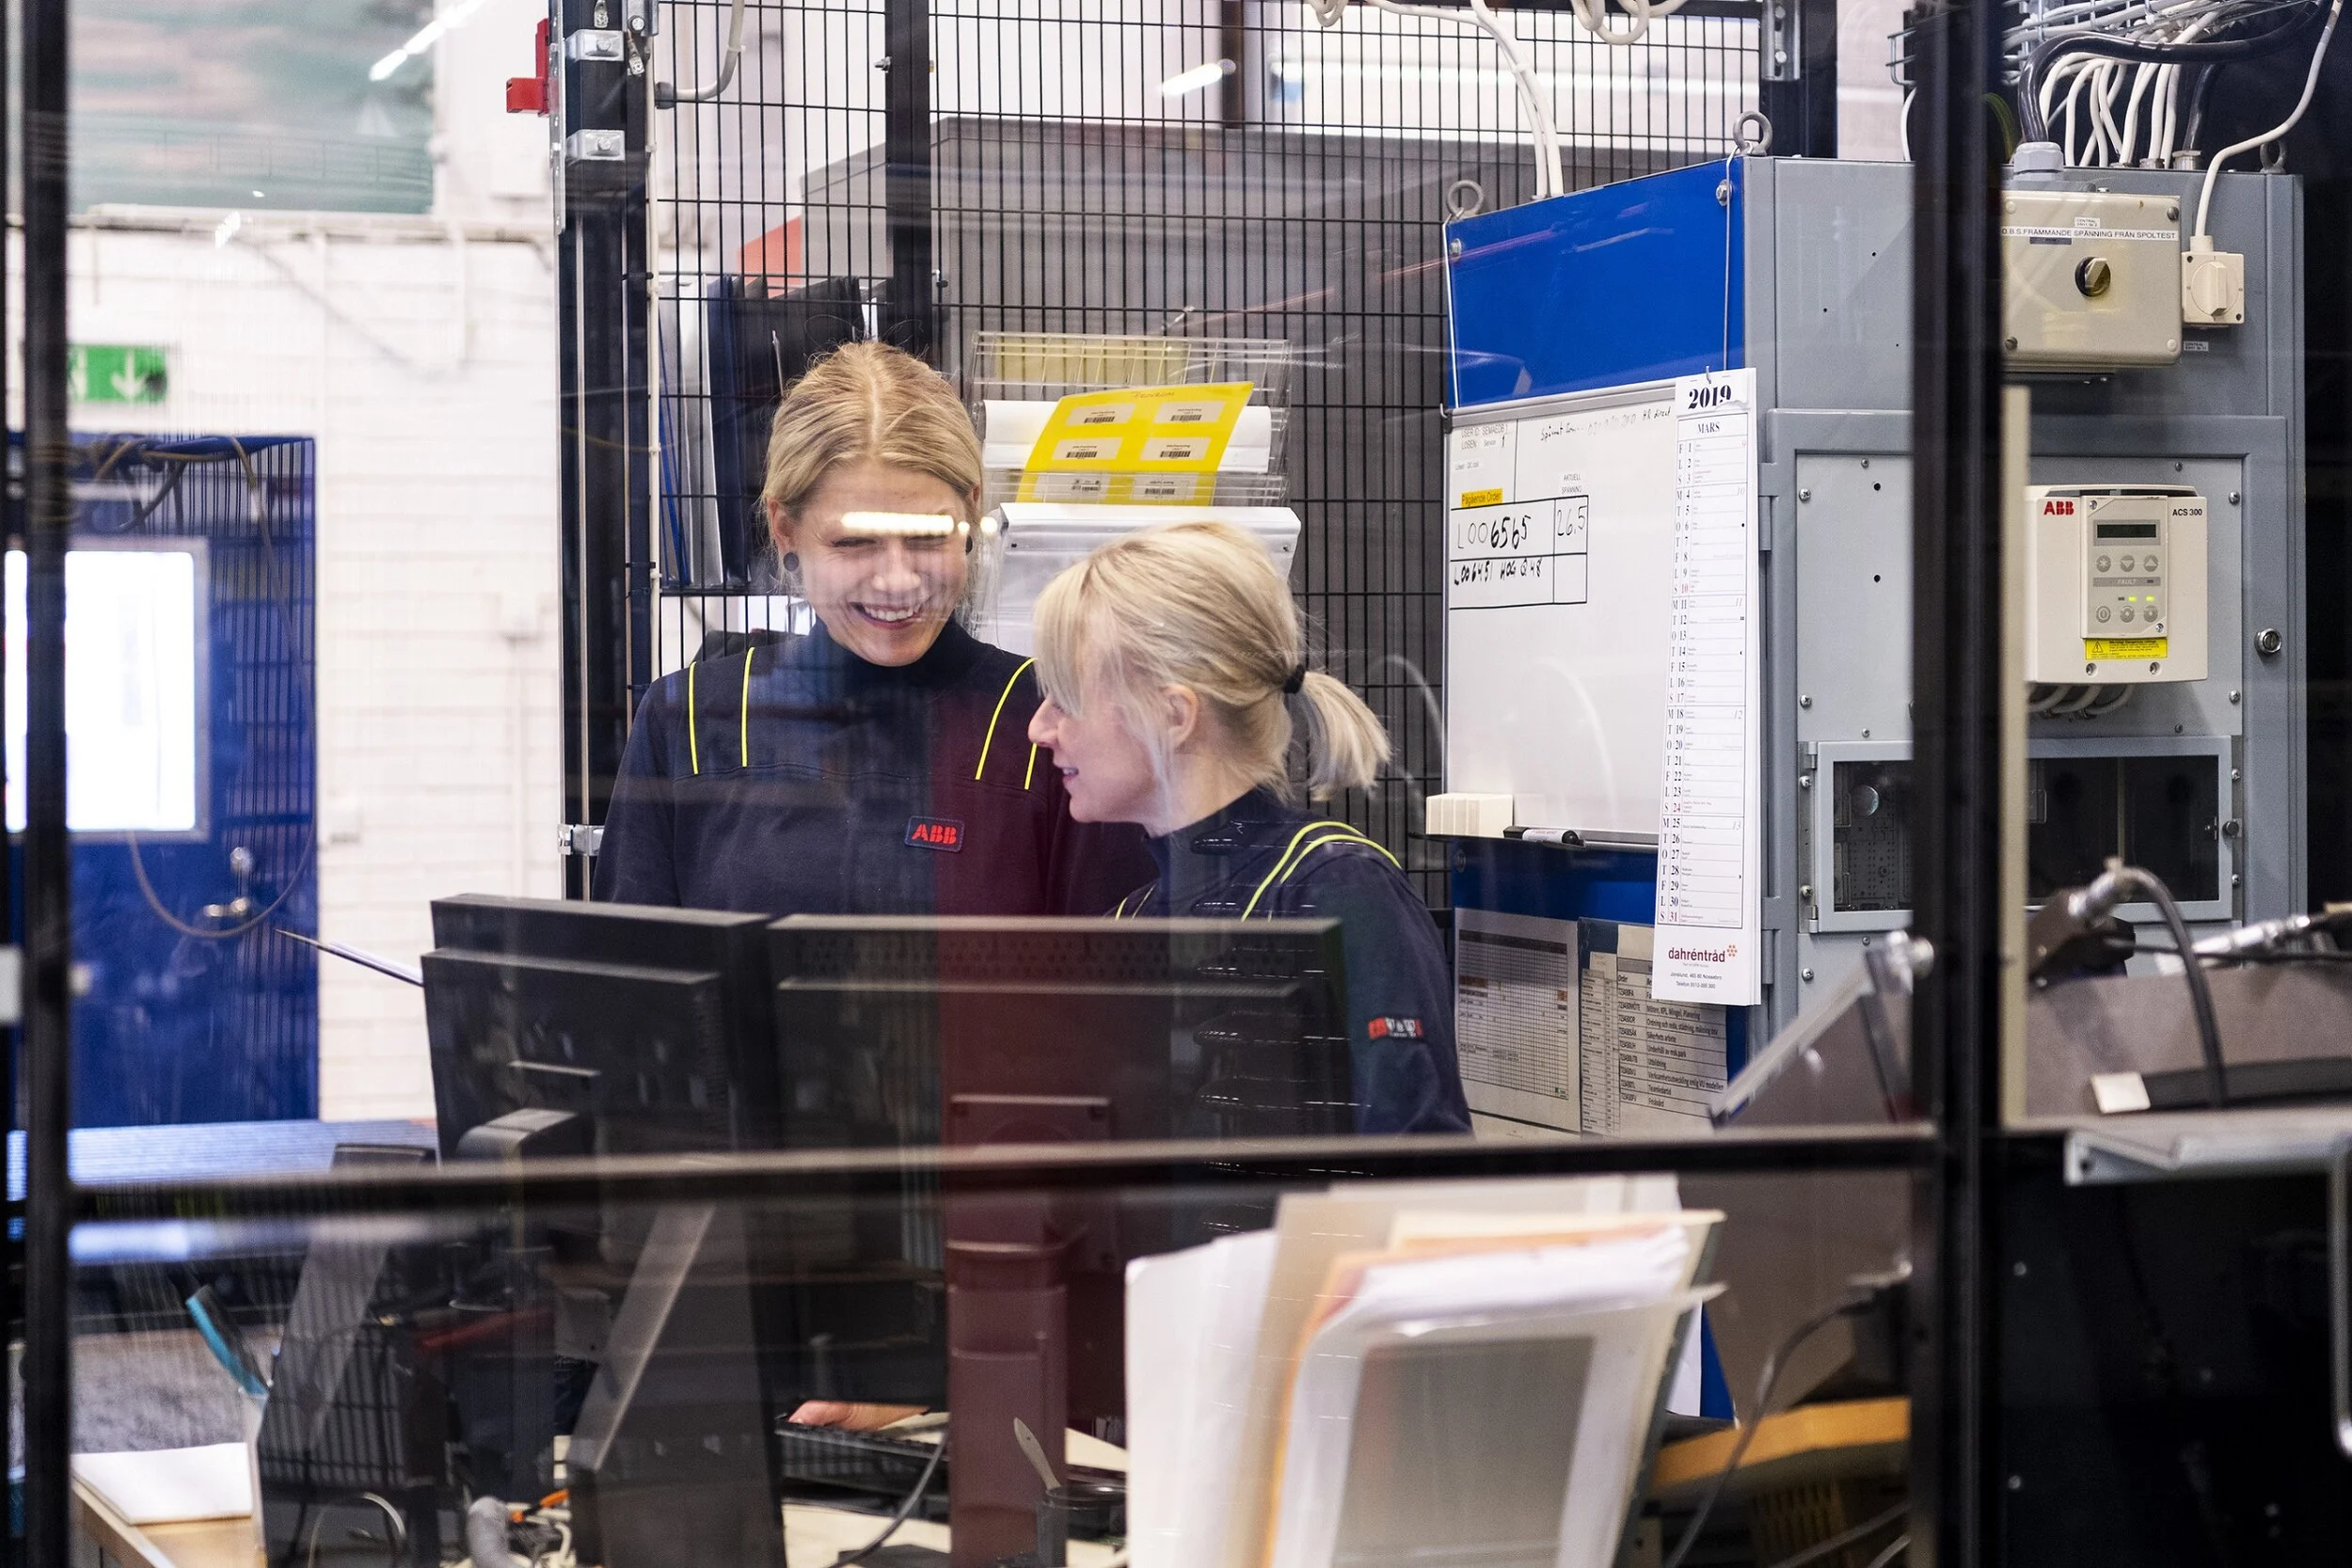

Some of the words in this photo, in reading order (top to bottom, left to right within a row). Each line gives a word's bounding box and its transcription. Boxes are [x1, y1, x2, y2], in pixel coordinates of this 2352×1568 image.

[1688, 384, 1731, 409] 2019
[1697, 421, 1720, 434] MARS
[1486, 491, 1502, 502] Order
[2043, 500, 2074, 515] ABB
[2171, 508, 2188, 516] ACS
[2189, 508, 2203, 516] 300
[1681, 584, 1688, 594] 10
[1681, 599, 1687, 610] 11
[1680, 615, 1687, 625] 12
[1679, 630, 1686, 641] 13
[1679, 646, 1686, 657] 14
[1678, 662, 1685, 672] 15
[1678, 678, 1685, 688] 16
[1677, 693, 1684, 703] 17
[1677, 709, 1684, 719] 18
[1676, 724, 1683, 735] 19
[1675, 740, 1682, 750] 20
[1675, 755, 1681, 766] 21
[1675, 771, 1682, 781] 22
[1674, 786, 1681, 797] 23
[1673, 803, 1680, 812] 24
[1673, 818, 1680, 828] 25
[911, 823, 958, 845] ABB
[1672, 833, 1680, 843] 26
[1672, 849, 1679, 859] 27
[1671, 865, 1679, 875] 28
[1671, 880, 1678, 891] 29
[1670, 896, 1678, 907] 30
[1670, 912, 1677, 922] 31
[1669, 947, 1725, 962] dahréntråd
